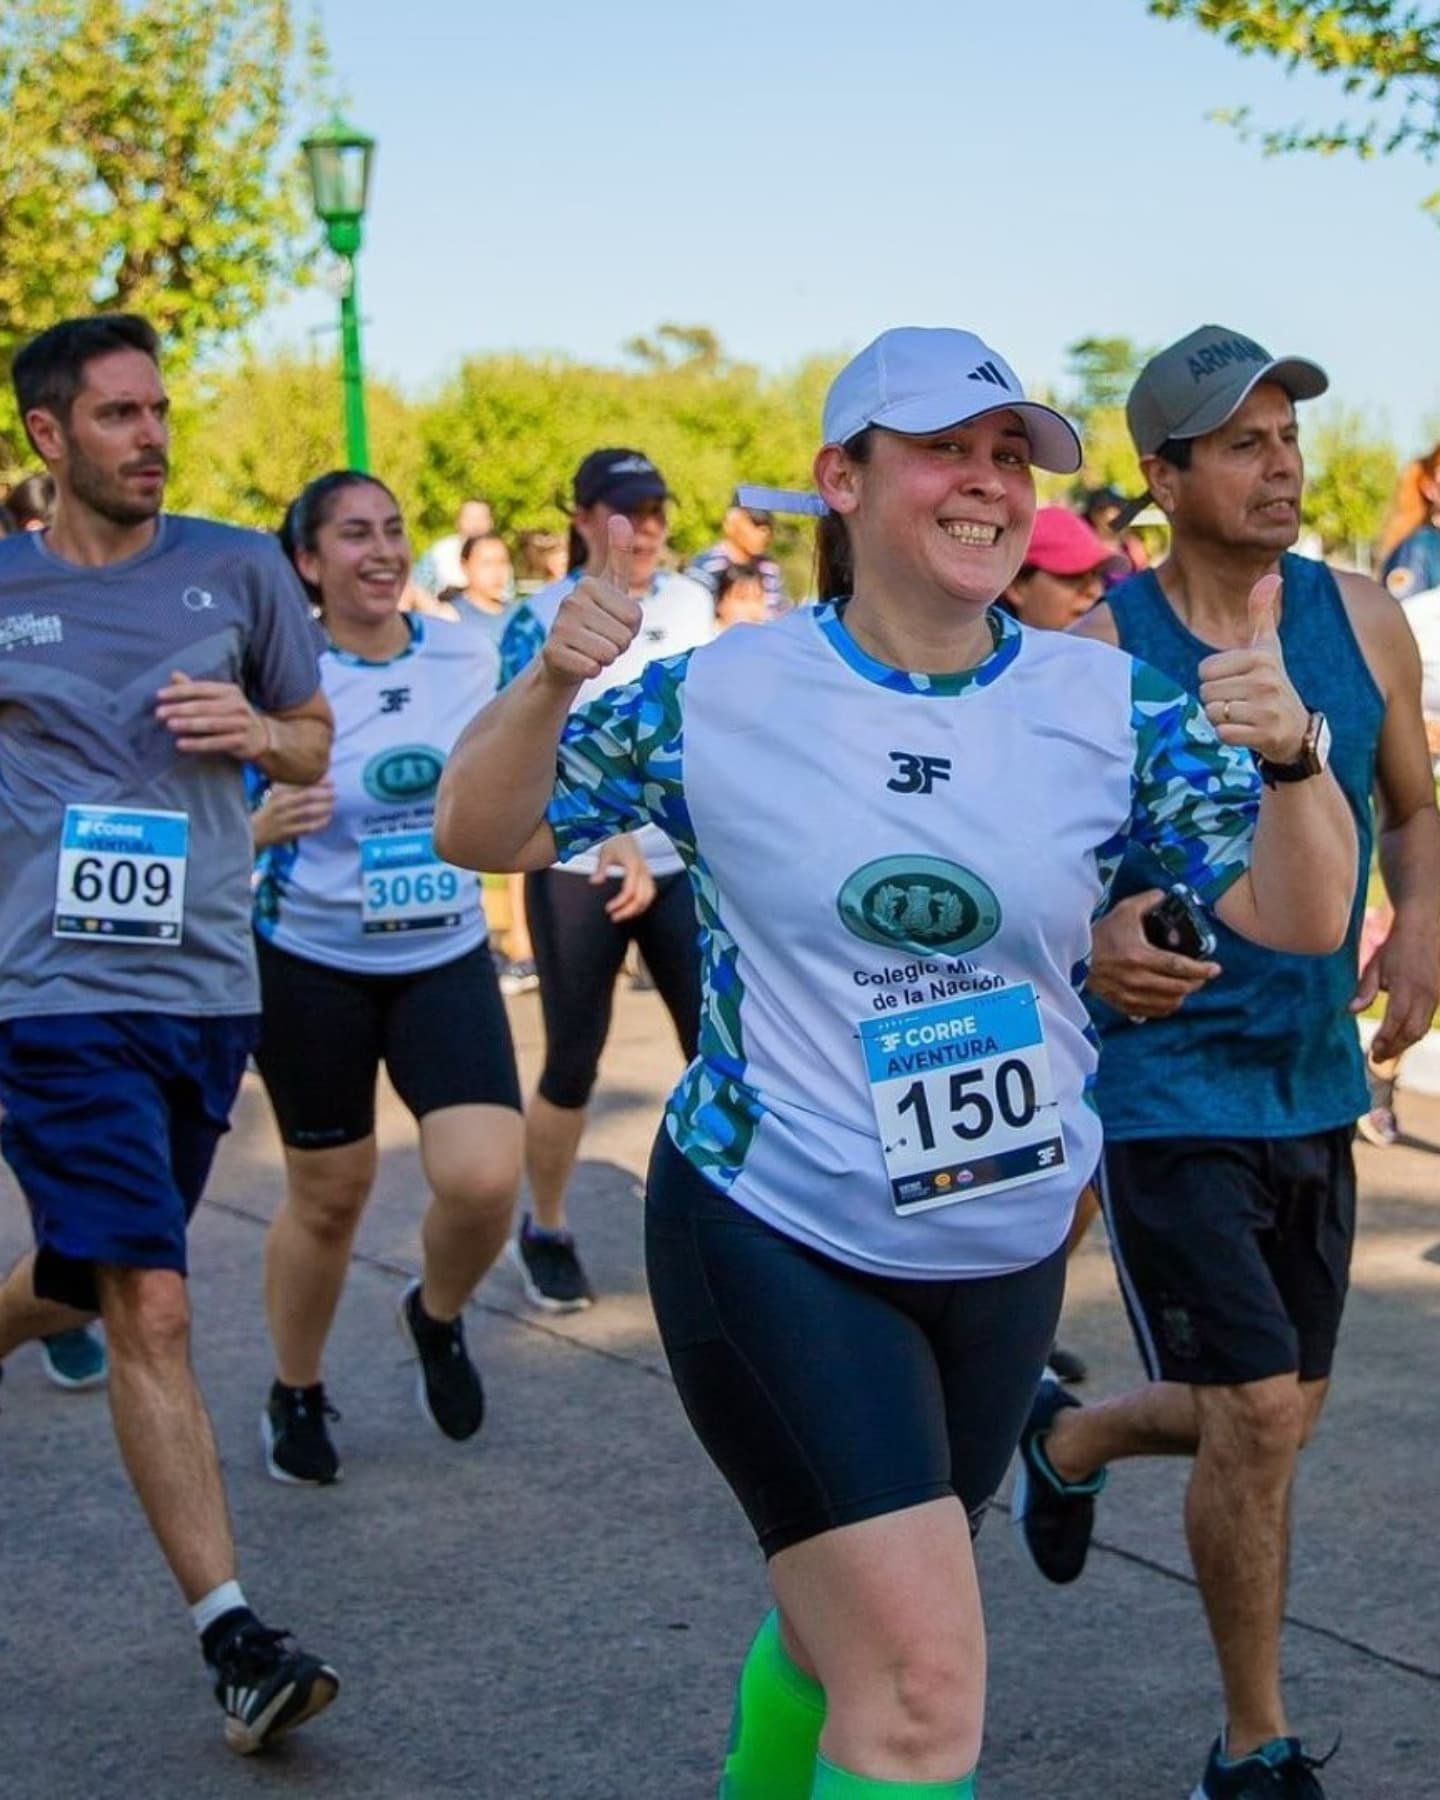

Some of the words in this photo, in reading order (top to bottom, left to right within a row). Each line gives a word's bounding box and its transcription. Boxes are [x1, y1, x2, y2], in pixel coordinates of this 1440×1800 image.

[380, 688, 412, 713] 3F
[886, 751, 952, 794] 3F
[73, 858, 172, 906] 609
[368, 870, 458, 911] 3069
[853, 959, 938, 987] Colegio
[872, 994, 898, 1011] de
[903, 989, 924, 1005] la
[930, 974, 1006, 1001] Nación
[905, 1015, 977, 1047] CORRE
[887, 1036, 998, 1077] AVENTURA
[897, 1058, 1036, 1151] 150
